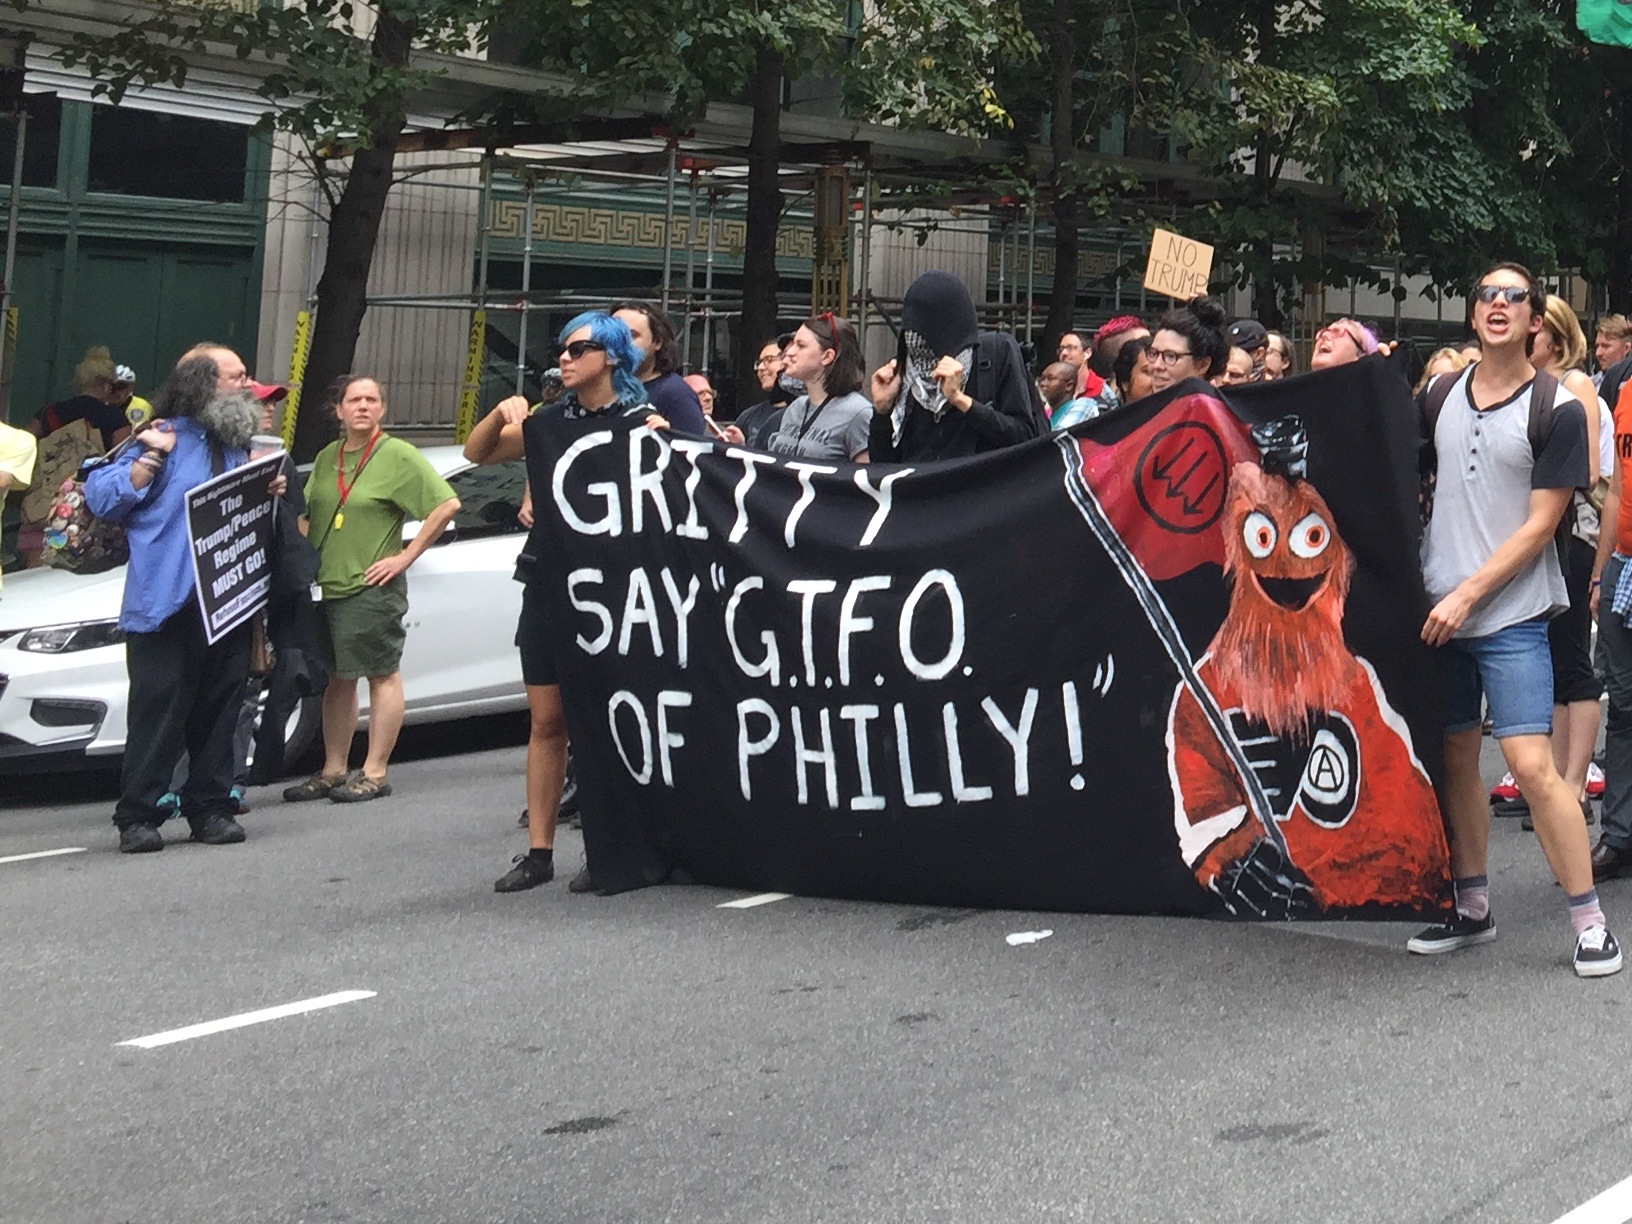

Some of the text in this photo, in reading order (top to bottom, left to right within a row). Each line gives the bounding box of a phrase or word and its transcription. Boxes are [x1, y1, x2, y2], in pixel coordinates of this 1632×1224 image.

[1151, 258, 1208, 294] TRUMP
[1166, 236, 1198, 268] NO
[219, 493, 244, 517] The
[552, 427, 915, 549] GRITTY
[194, 500, 271, 556] Trump/Pence
[213, 530, 257, 570] Regime
[211, 546, 267, 599] MUST GO!
[568, 567, 700, 669] SAY
[608, 653, 1115, 810] OF PHILLY!"
